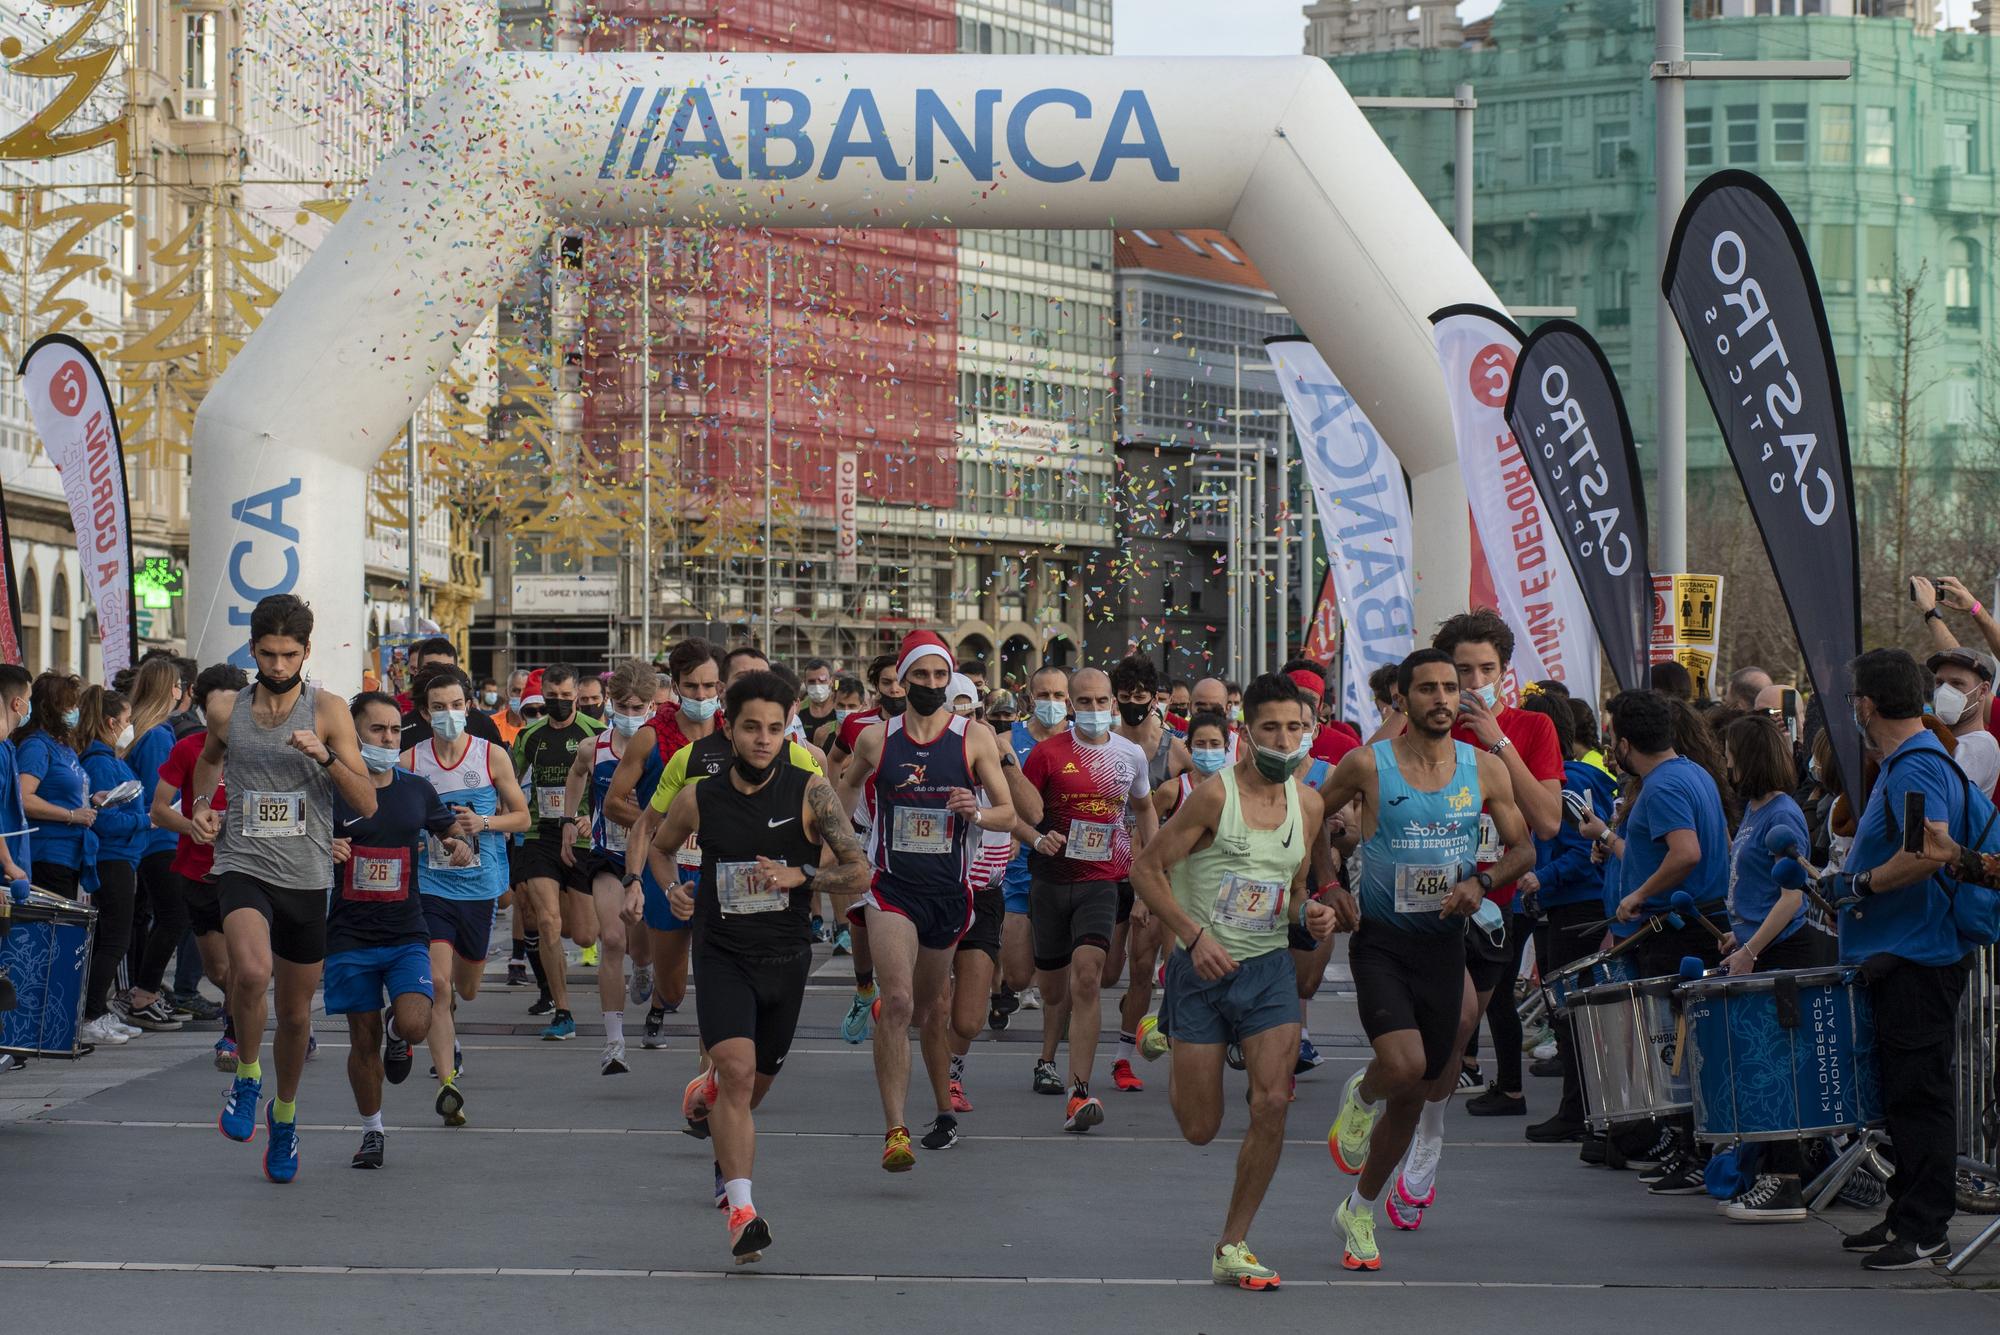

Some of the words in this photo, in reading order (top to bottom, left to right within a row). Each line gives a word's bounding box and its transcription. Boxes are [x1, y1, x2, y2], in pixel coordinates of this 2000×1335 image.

[551, 796, 560, 807] 16
[259, 804, 288, 822] 932
[916, 821, 930, 837] 13
[1088, 833, 1103, 848] 57
[1392, 839, 1420, 849] CLUBE
[369, 864, 387, 881] 26
[1416, 876, 1449, 895] 484
[1247, 893, 1260, 912] 2
[1824, 985, 1835, 1028] ALTO
[1813, 998, 1830, 1113] KILOMBEROS
[1829, 1033, 1841, 1095] MONTE
[1834, 1100, 1844, 1123] DE
